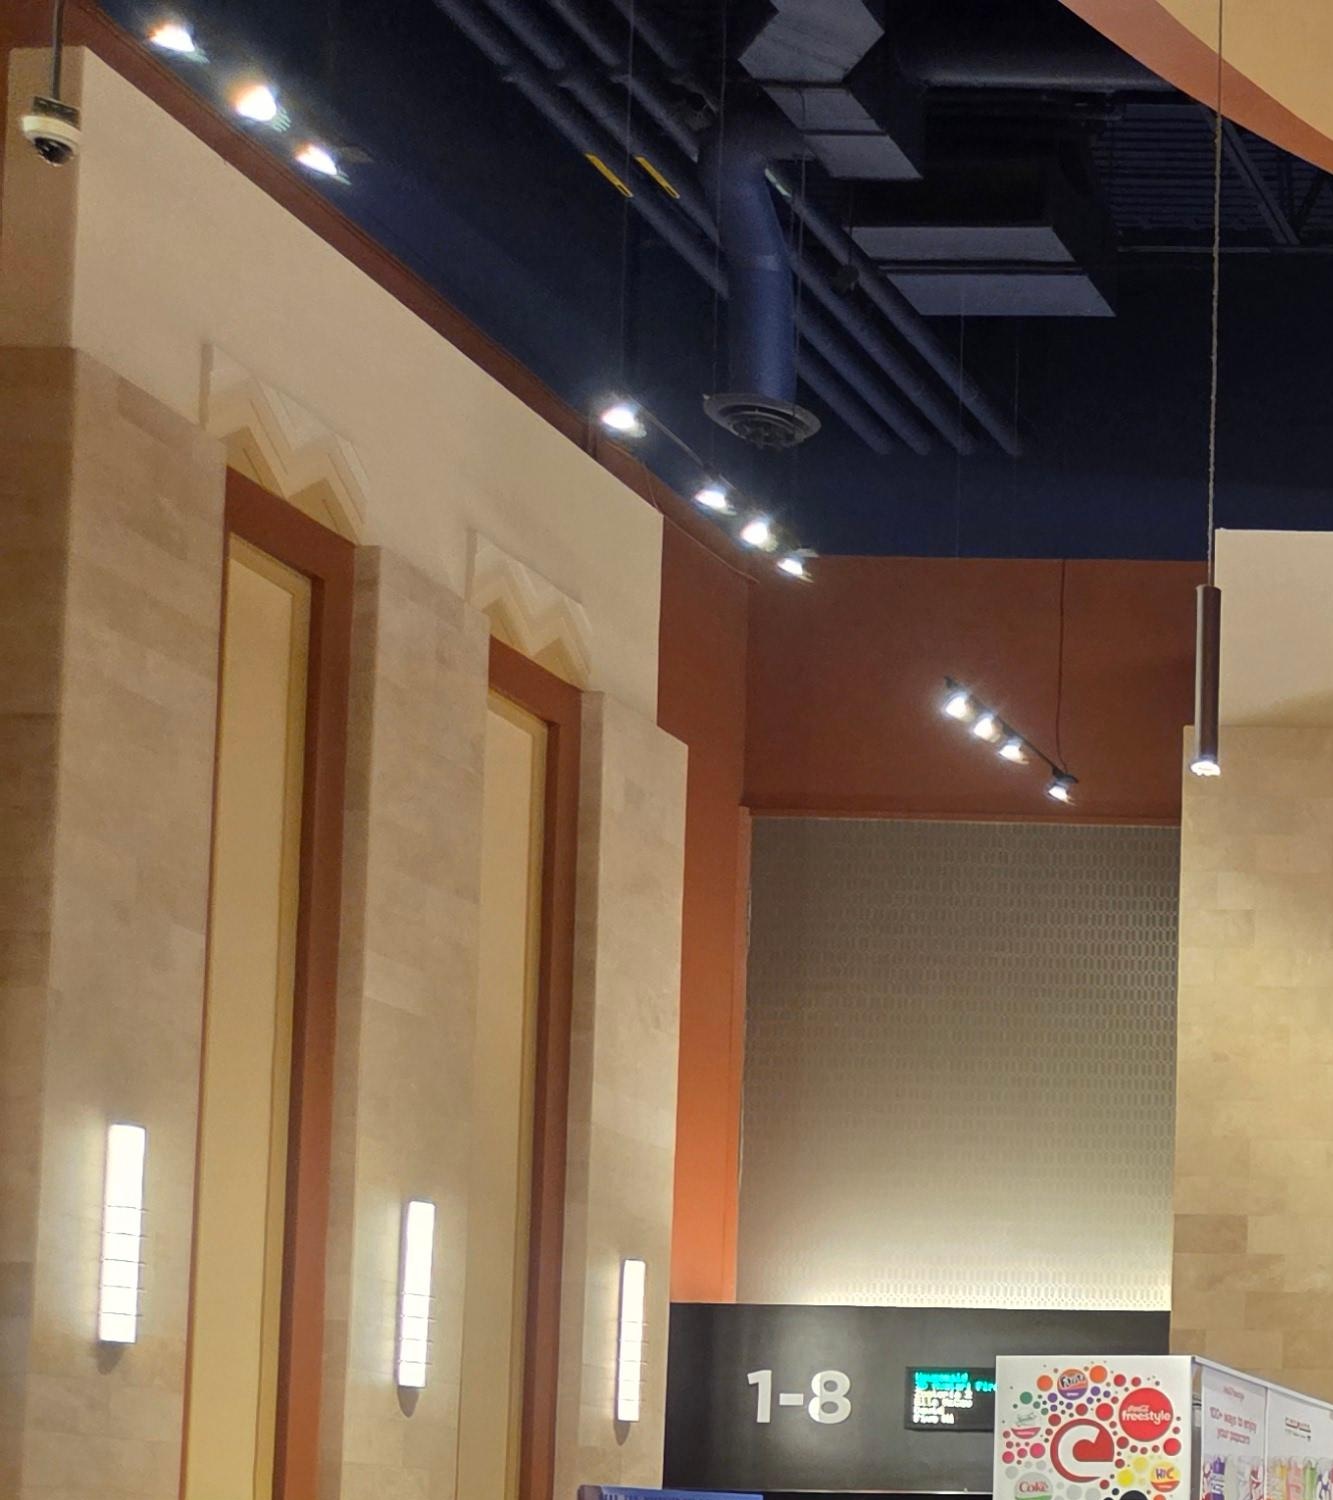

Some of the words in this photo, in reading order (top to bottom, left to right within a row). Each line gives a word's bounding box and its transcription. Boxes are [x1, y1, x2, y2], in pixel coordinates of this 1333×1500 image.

[747, 1370, 851, 1424] 1-8
[1122, 1410, 1171, 1425] freestyle
[1019, 1481, 1048, 1493] Coke
